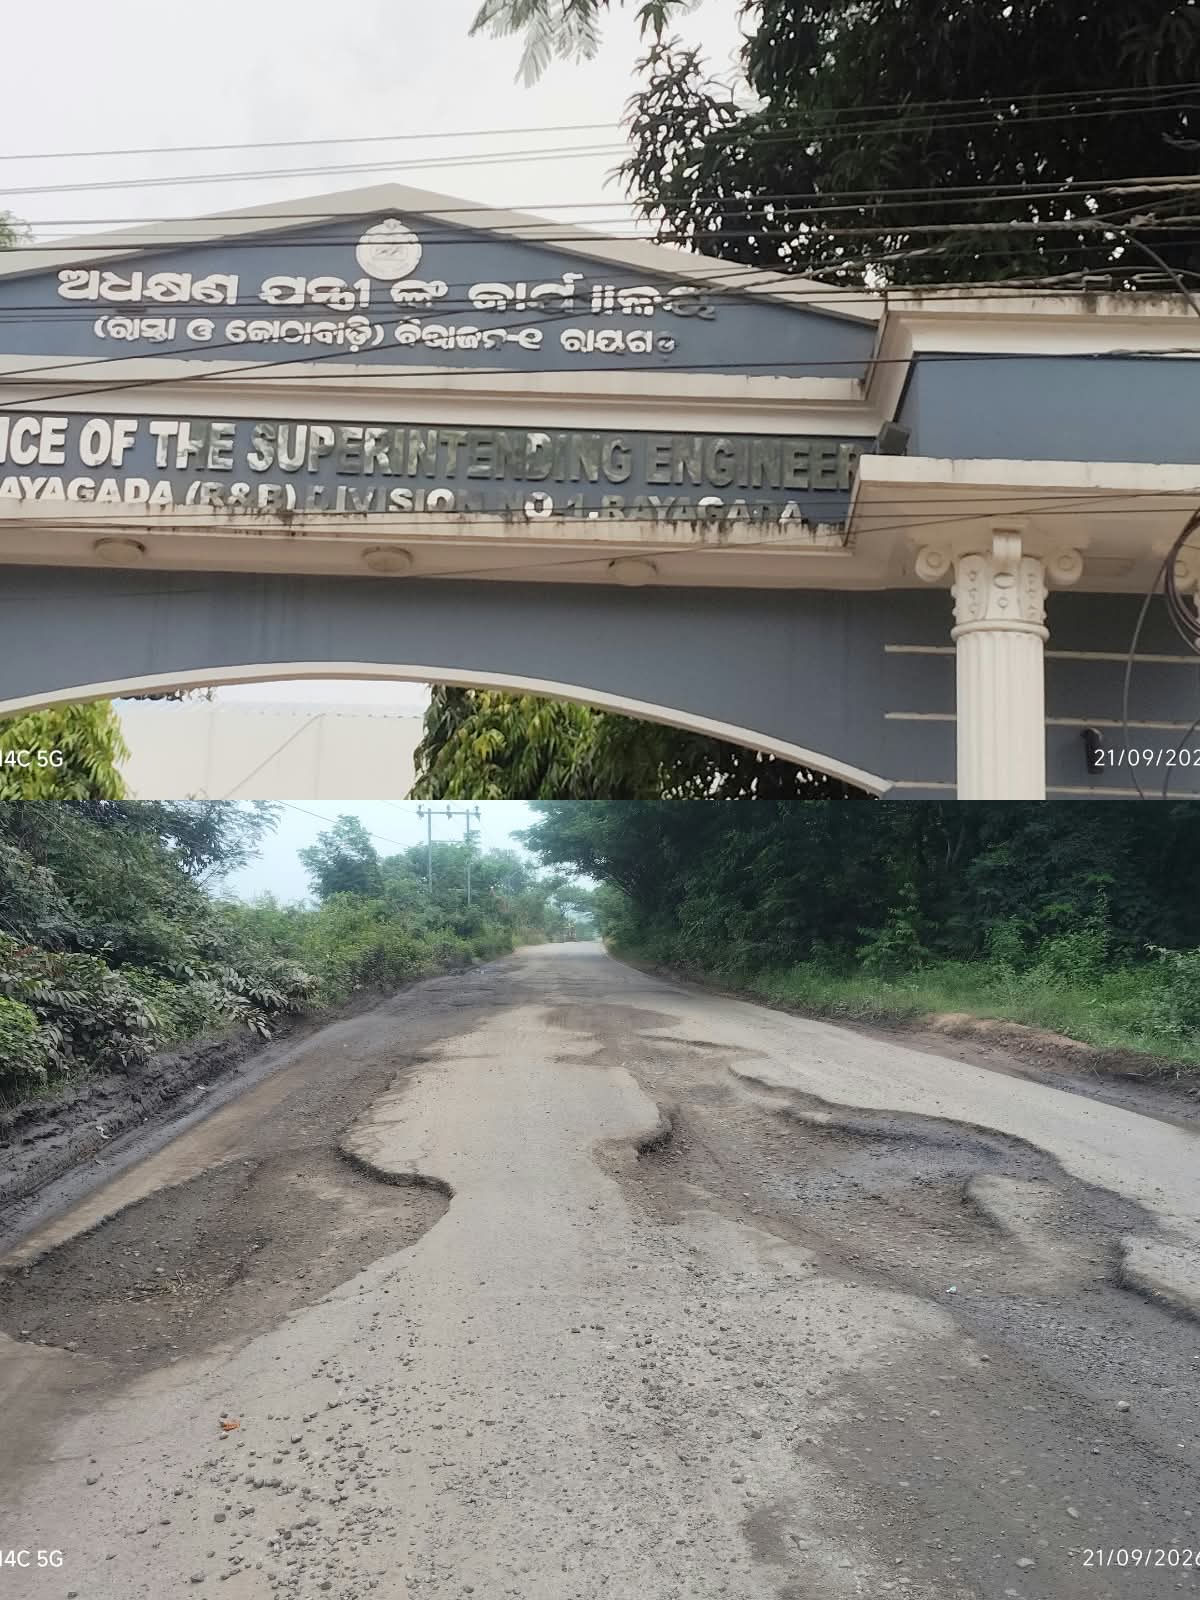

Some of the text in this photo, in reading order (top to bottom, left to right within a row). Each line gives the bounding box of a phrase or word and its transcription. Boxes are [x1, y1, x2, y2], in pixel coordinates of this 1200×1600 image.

[79, 418, 138, 468] OF
[150, 421, 237, 471] THE
[246, 423, 633, 484] SUPERINTENDING
